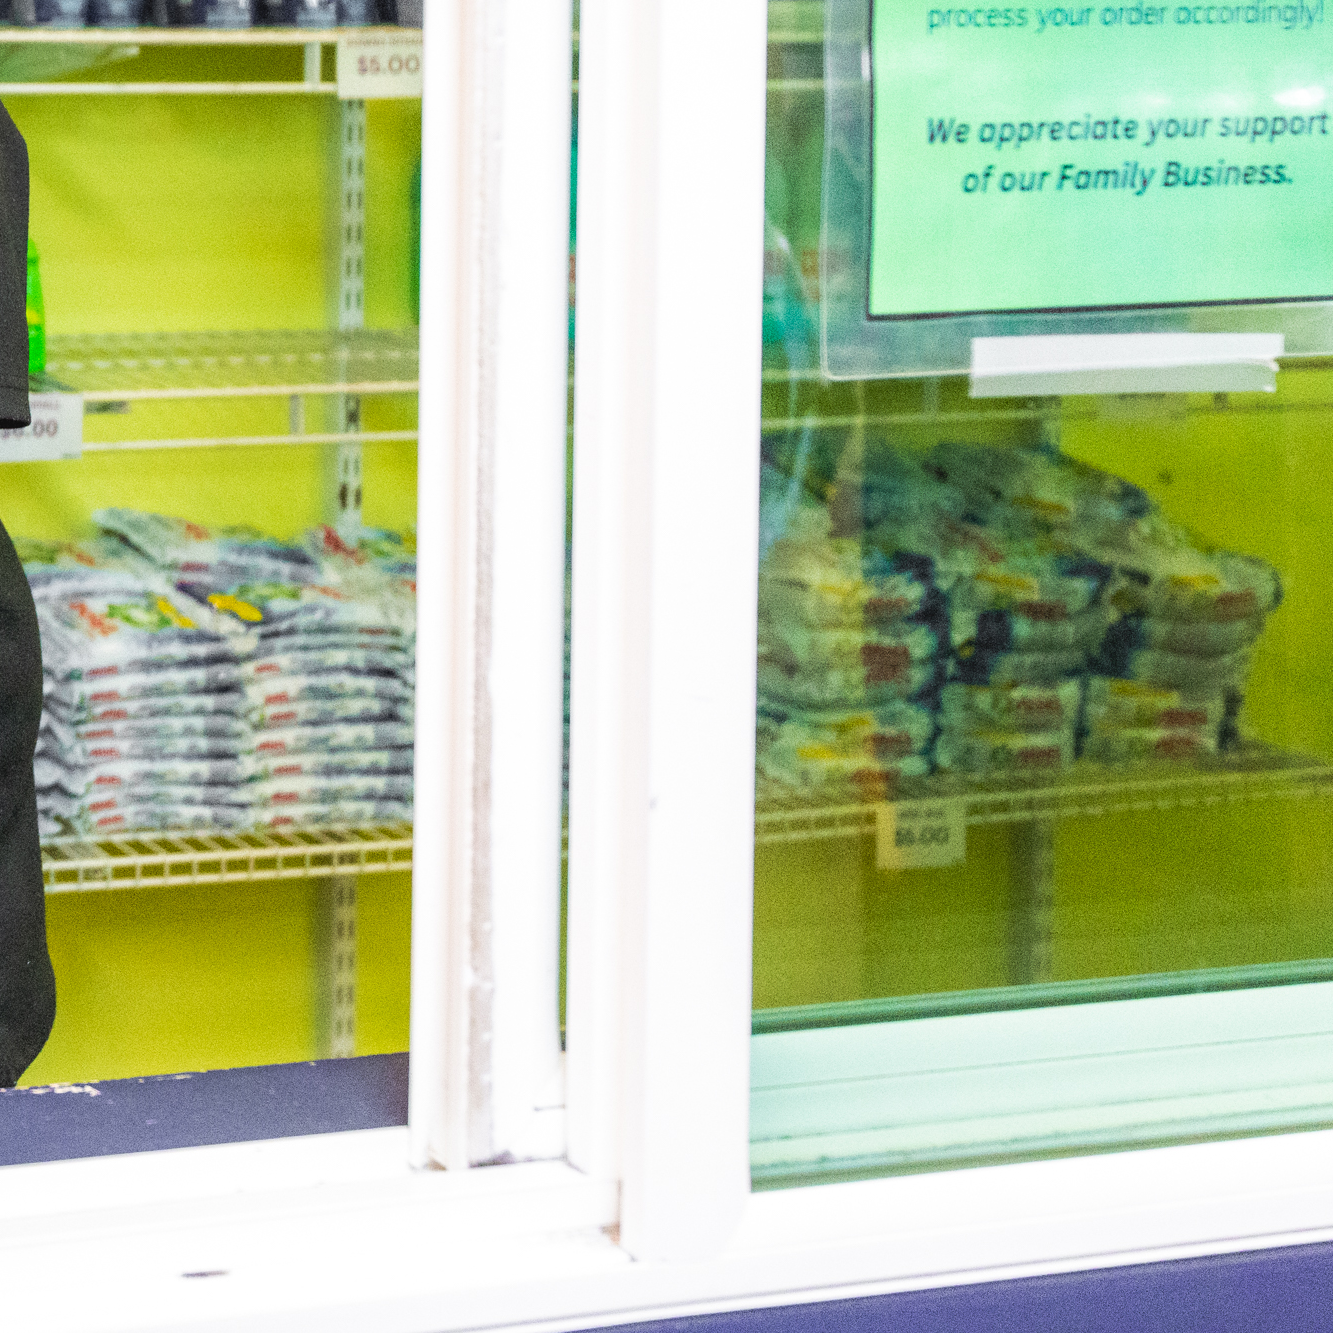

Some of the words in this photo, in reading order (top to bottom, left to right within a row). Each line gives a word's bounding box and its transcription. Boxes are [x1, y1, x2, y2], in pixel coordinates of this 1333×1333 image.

[927, 5, 1028, 34] process
[1037, 7, 1092, 33] your
[1101, 1, 1166, 26] order
[1173, 0, 1325, 30] accordingly!
[357, 55, 420, 75] $5.00
[927, 118, 973, 145] We
[979, 113, 1137, 150] appreciate
[1145, 120, 1211, 147] your
[1219, 112, 1330, 141] support
[963, 165, 994, 193] of
[1002, 168, 1050, 192] our
[1056, 162, 1155, 195] Family
[1162, 160, 1293, 188] Business.
